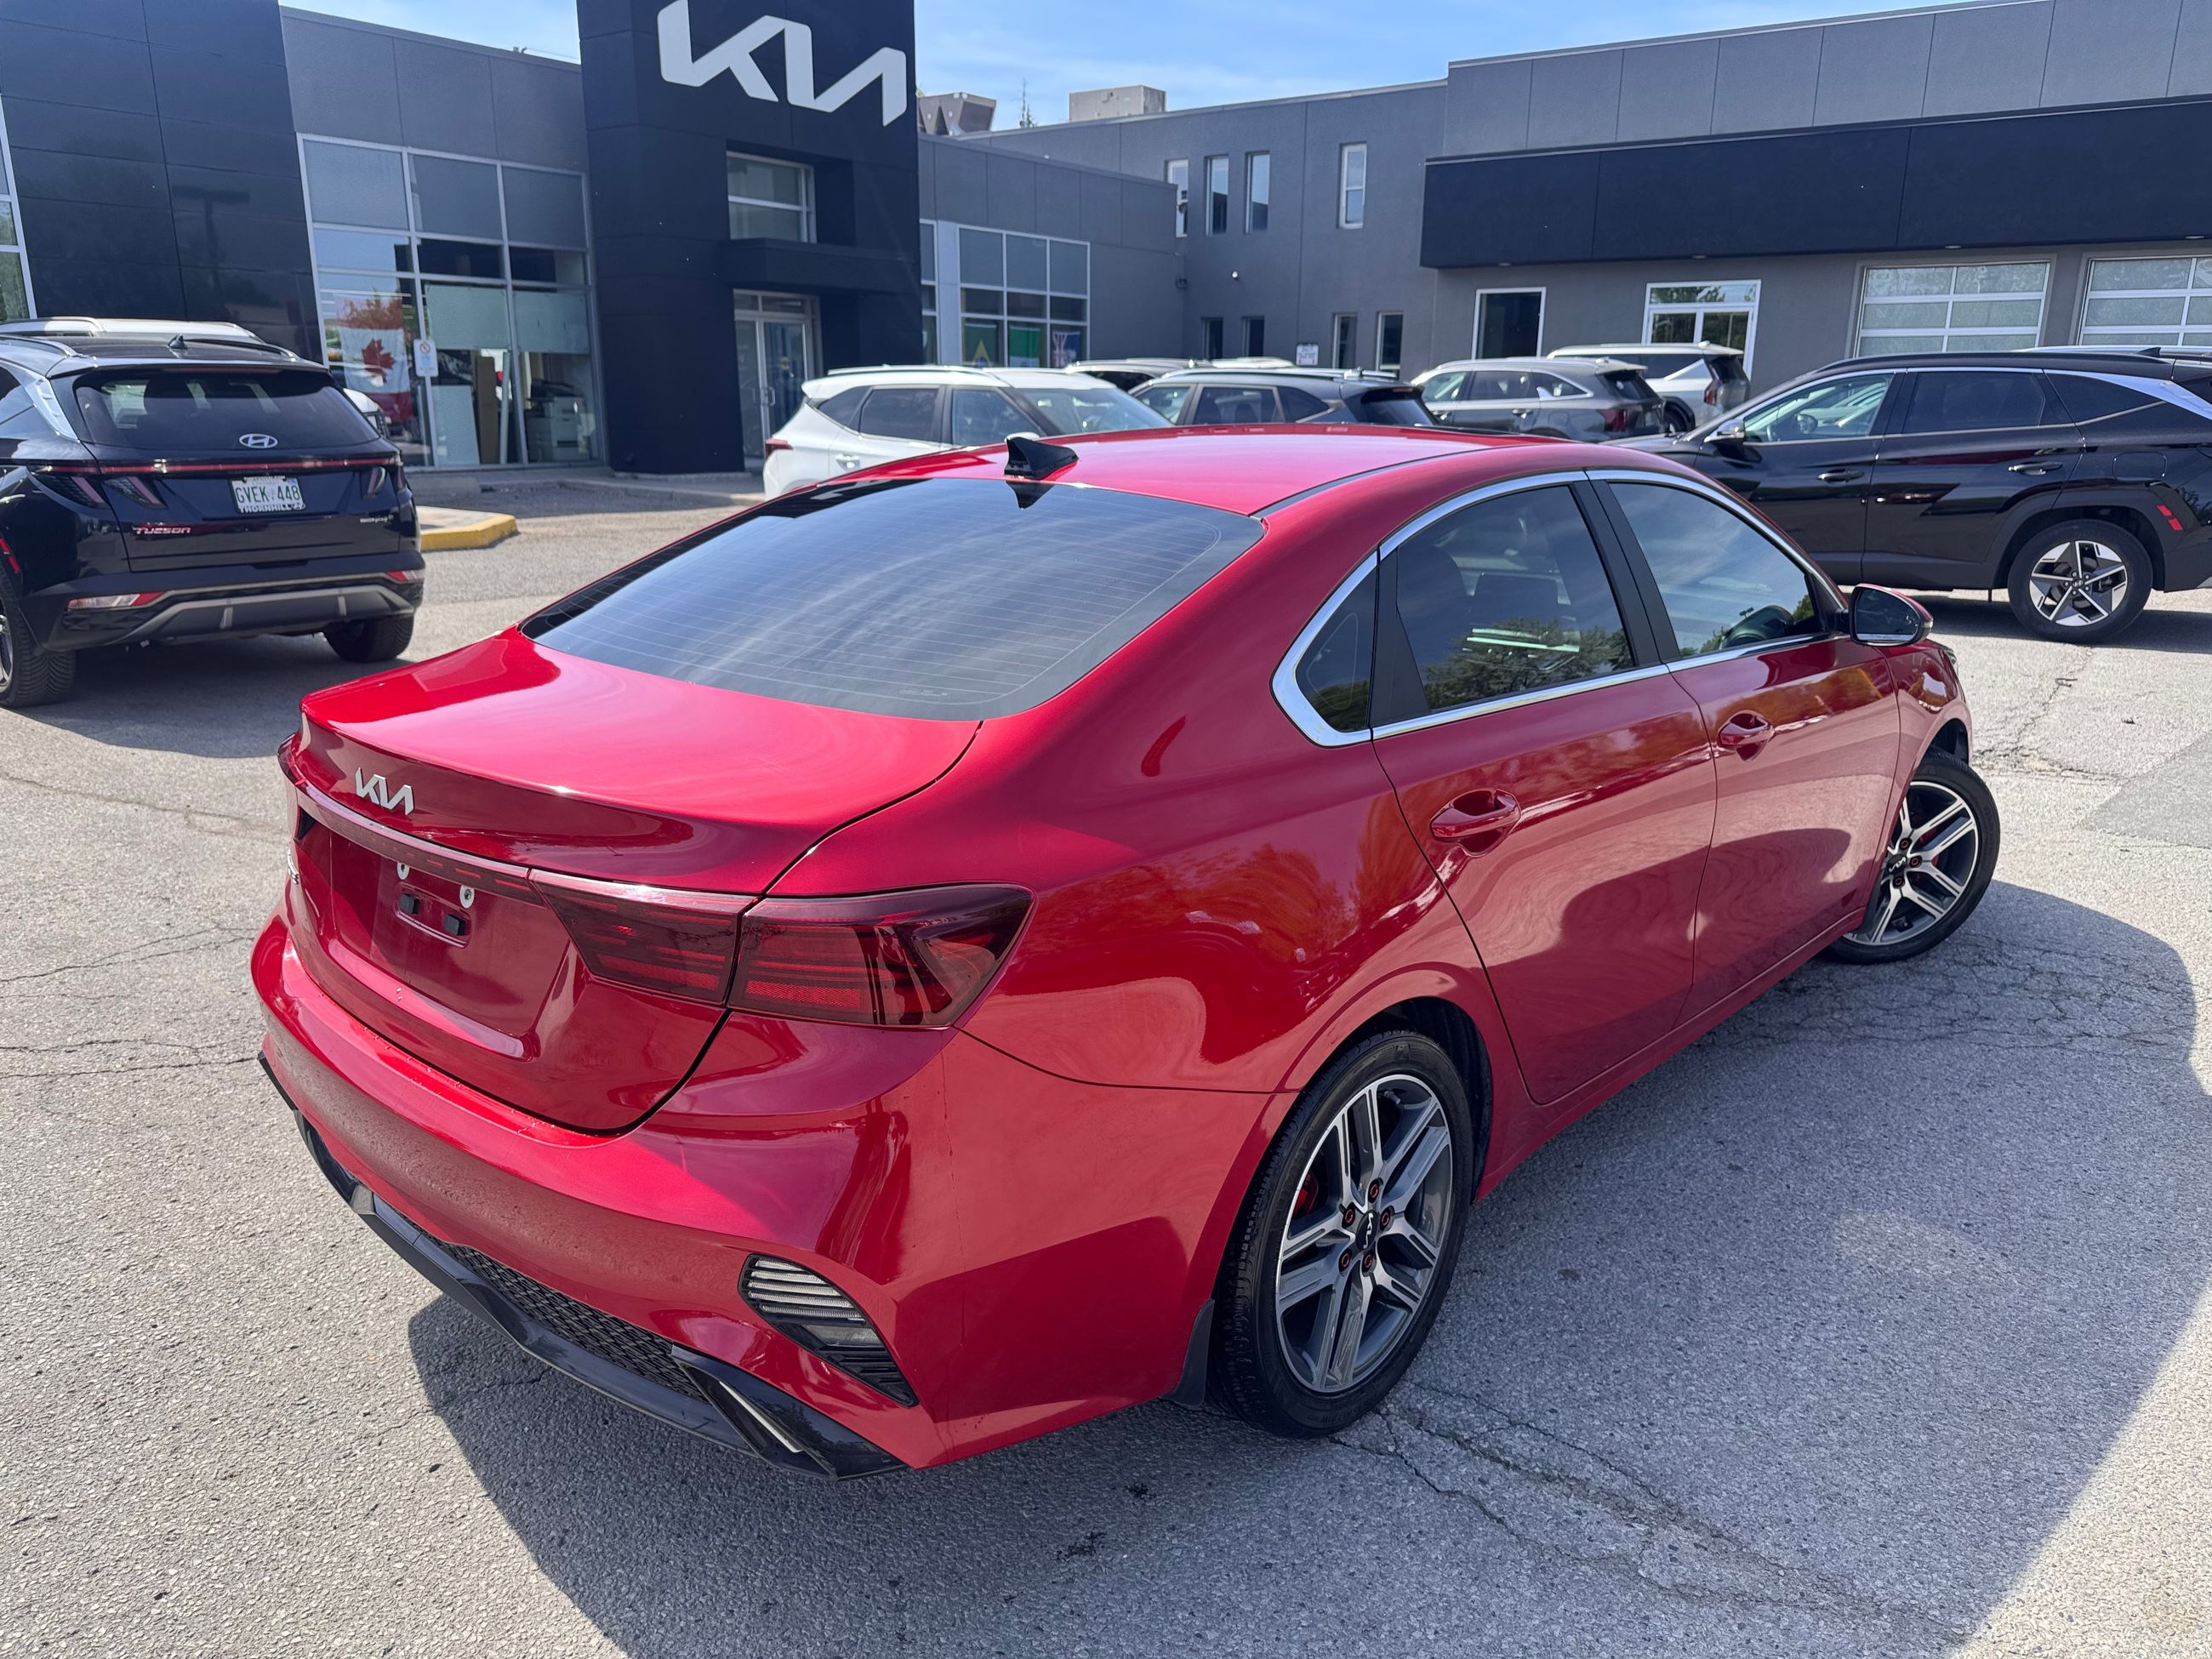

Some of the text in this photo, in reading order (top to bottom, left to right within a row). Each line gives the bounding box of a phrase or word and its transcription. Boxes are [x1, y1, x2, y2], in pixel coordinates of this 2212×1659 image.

[658, 0, 907, 127] KIA
[235, 485, 300, 504] GVEK 448
[133, 527, 191, 535] TUCSON
[355, 767, 415, 816] KIA
